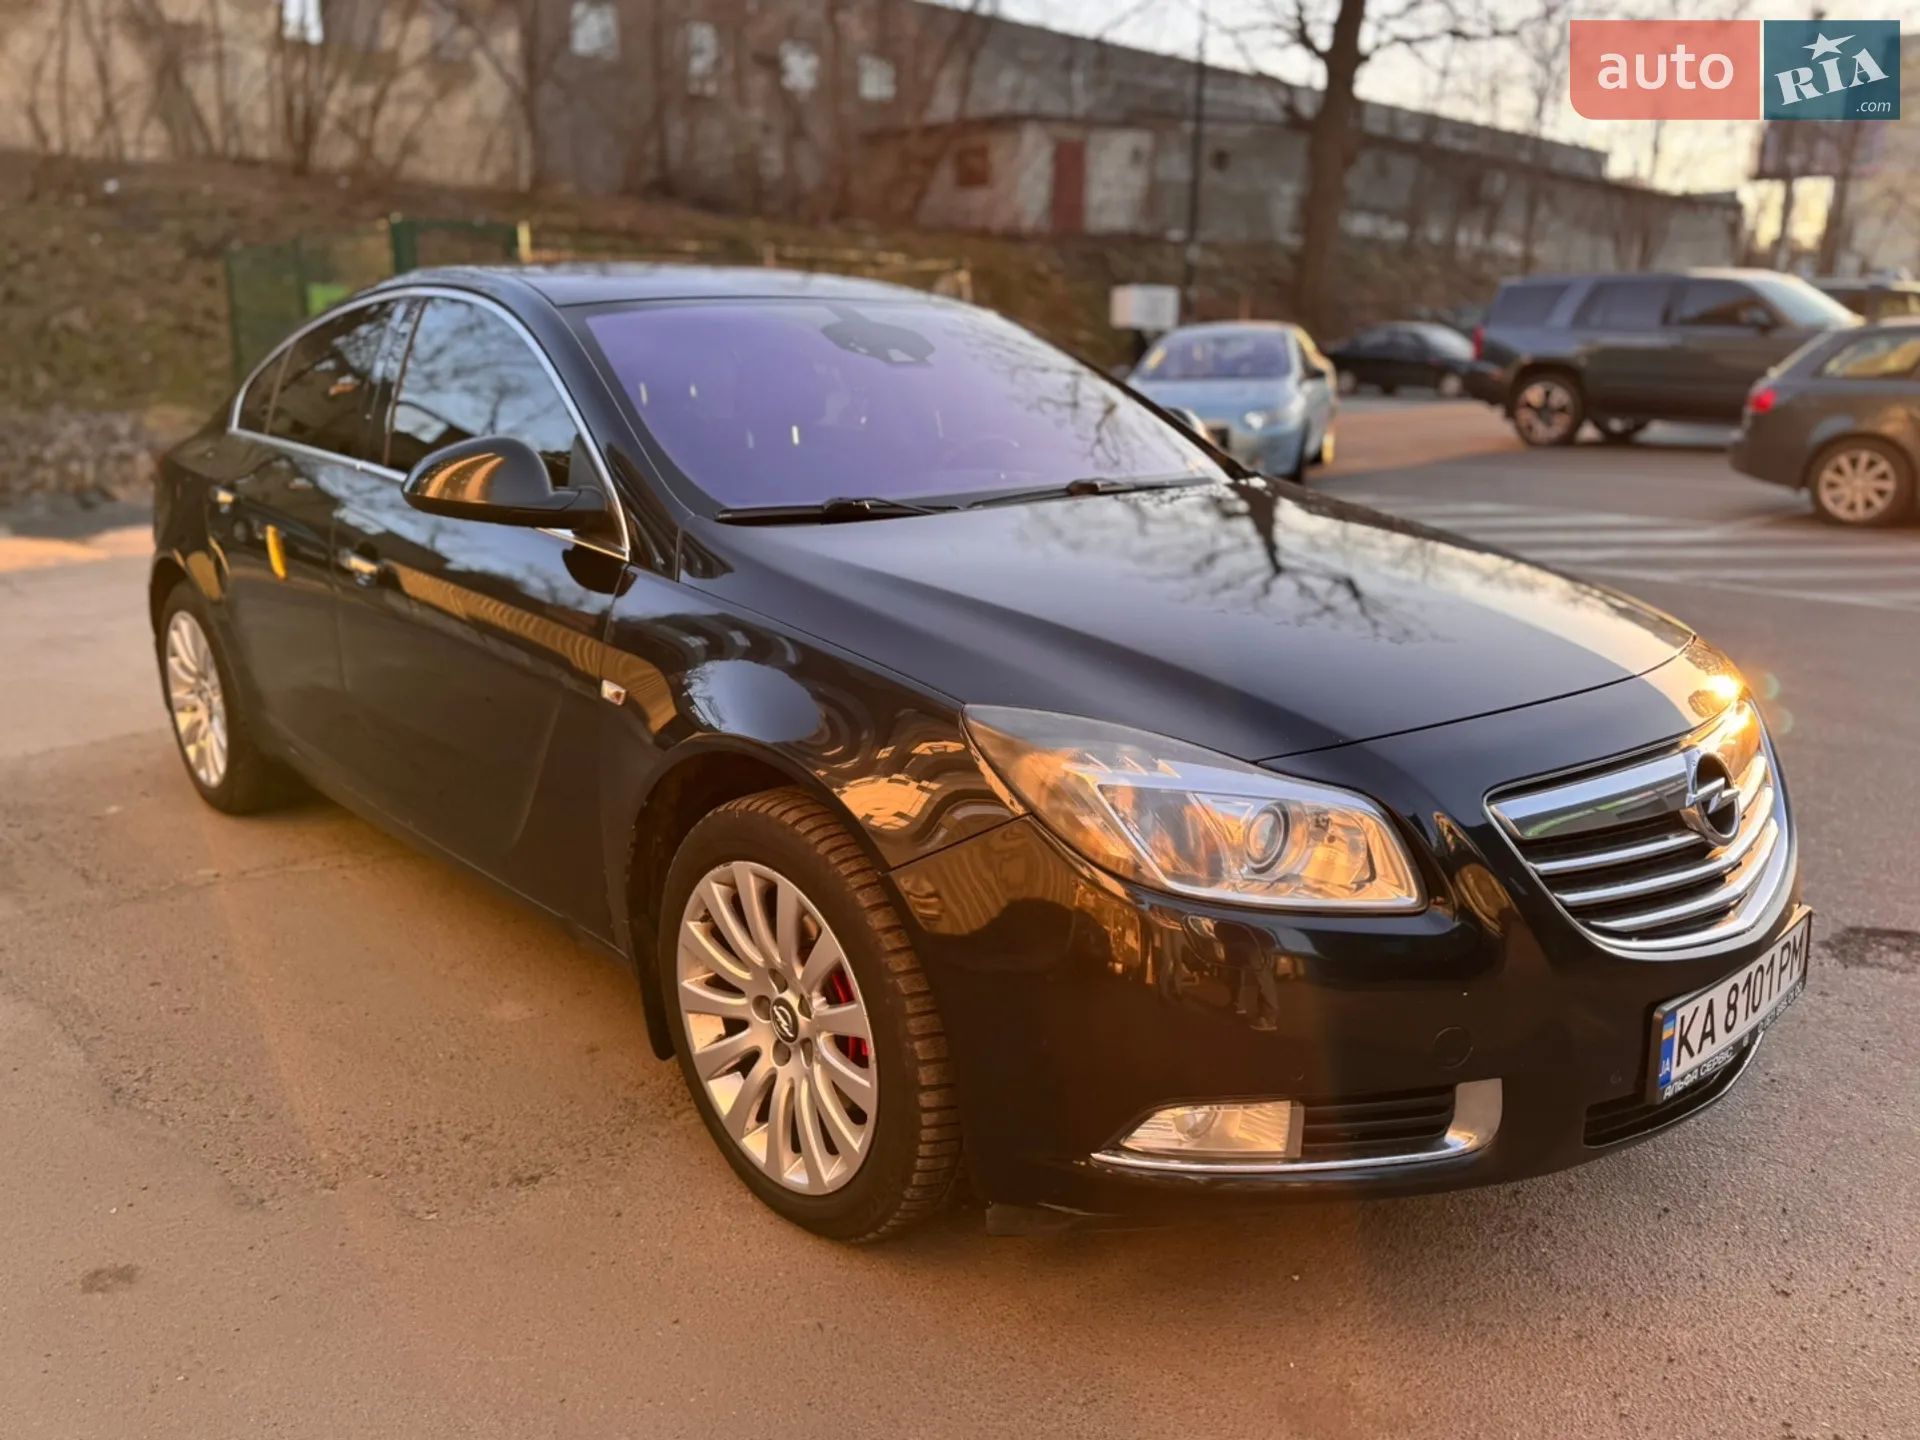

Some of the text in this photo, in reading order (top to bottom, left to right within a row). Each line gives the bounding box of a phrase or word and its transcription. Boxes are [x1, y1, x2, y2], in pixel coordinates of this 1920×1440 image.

[1675, 998, 1716, 1067] KA
[1724, 953, 1776, 1035] 8101
[1777, 928, 1805, 993] PM
